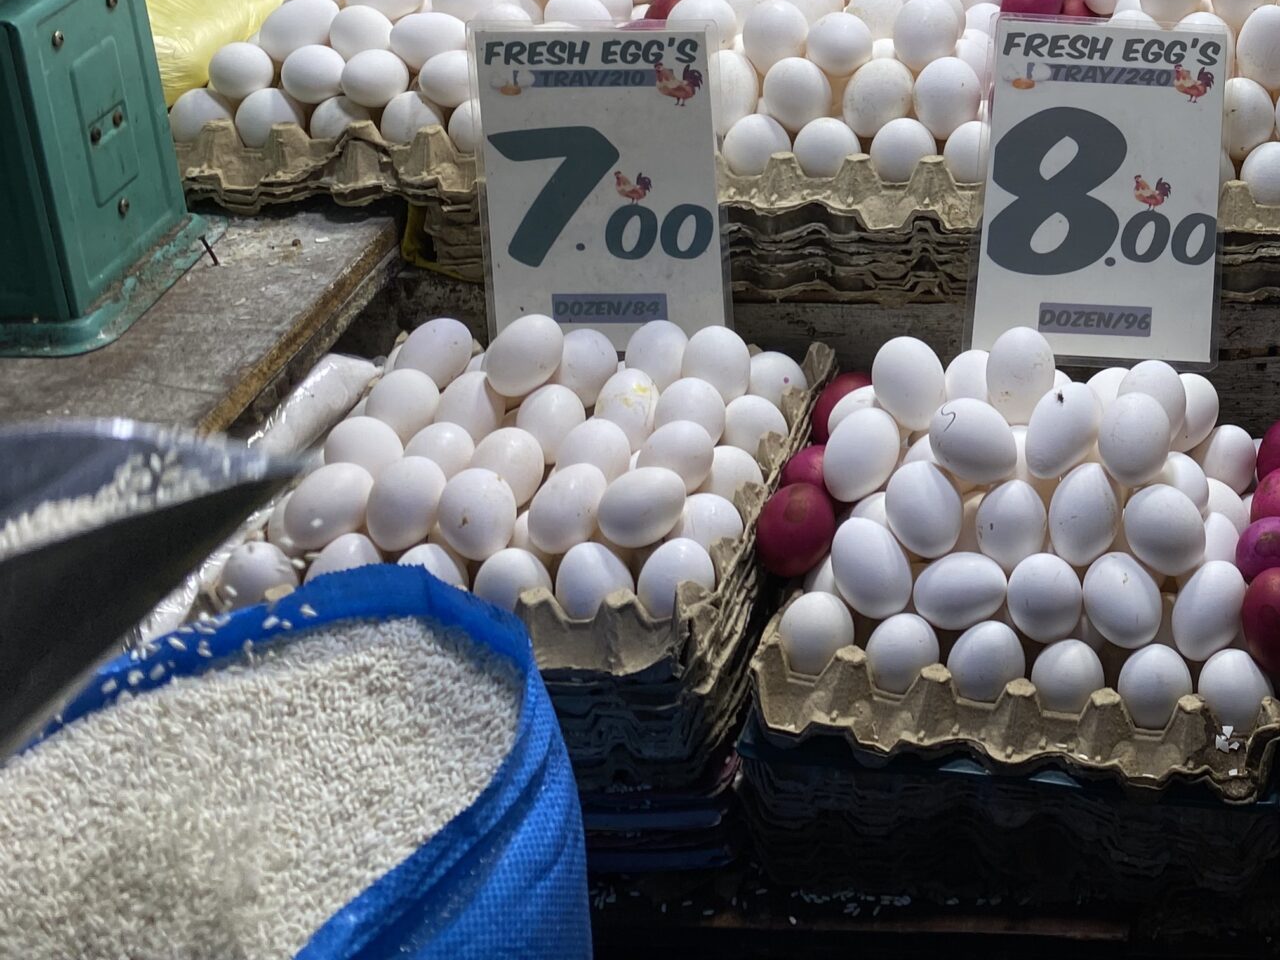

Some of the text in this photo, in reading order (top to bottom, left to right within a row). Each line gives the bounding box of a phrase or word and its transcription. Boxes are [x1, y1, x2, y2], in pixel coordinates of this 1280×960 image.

[484, 37, 698, 66] FRESH EGG'S
[1002, 32, 1221, 66] FRESH EGG'S
[540, 70, 645, 87] TRAY/210
[1050, 64, 1172, 86] TRAY/240
[487, 126, 714, 268] 7.00
[986, 106, 1217, 276] 8.00
[554, 300, 661, 317] DOZEN/84
[1039, 309, 1150, 331] DOZEN/96
